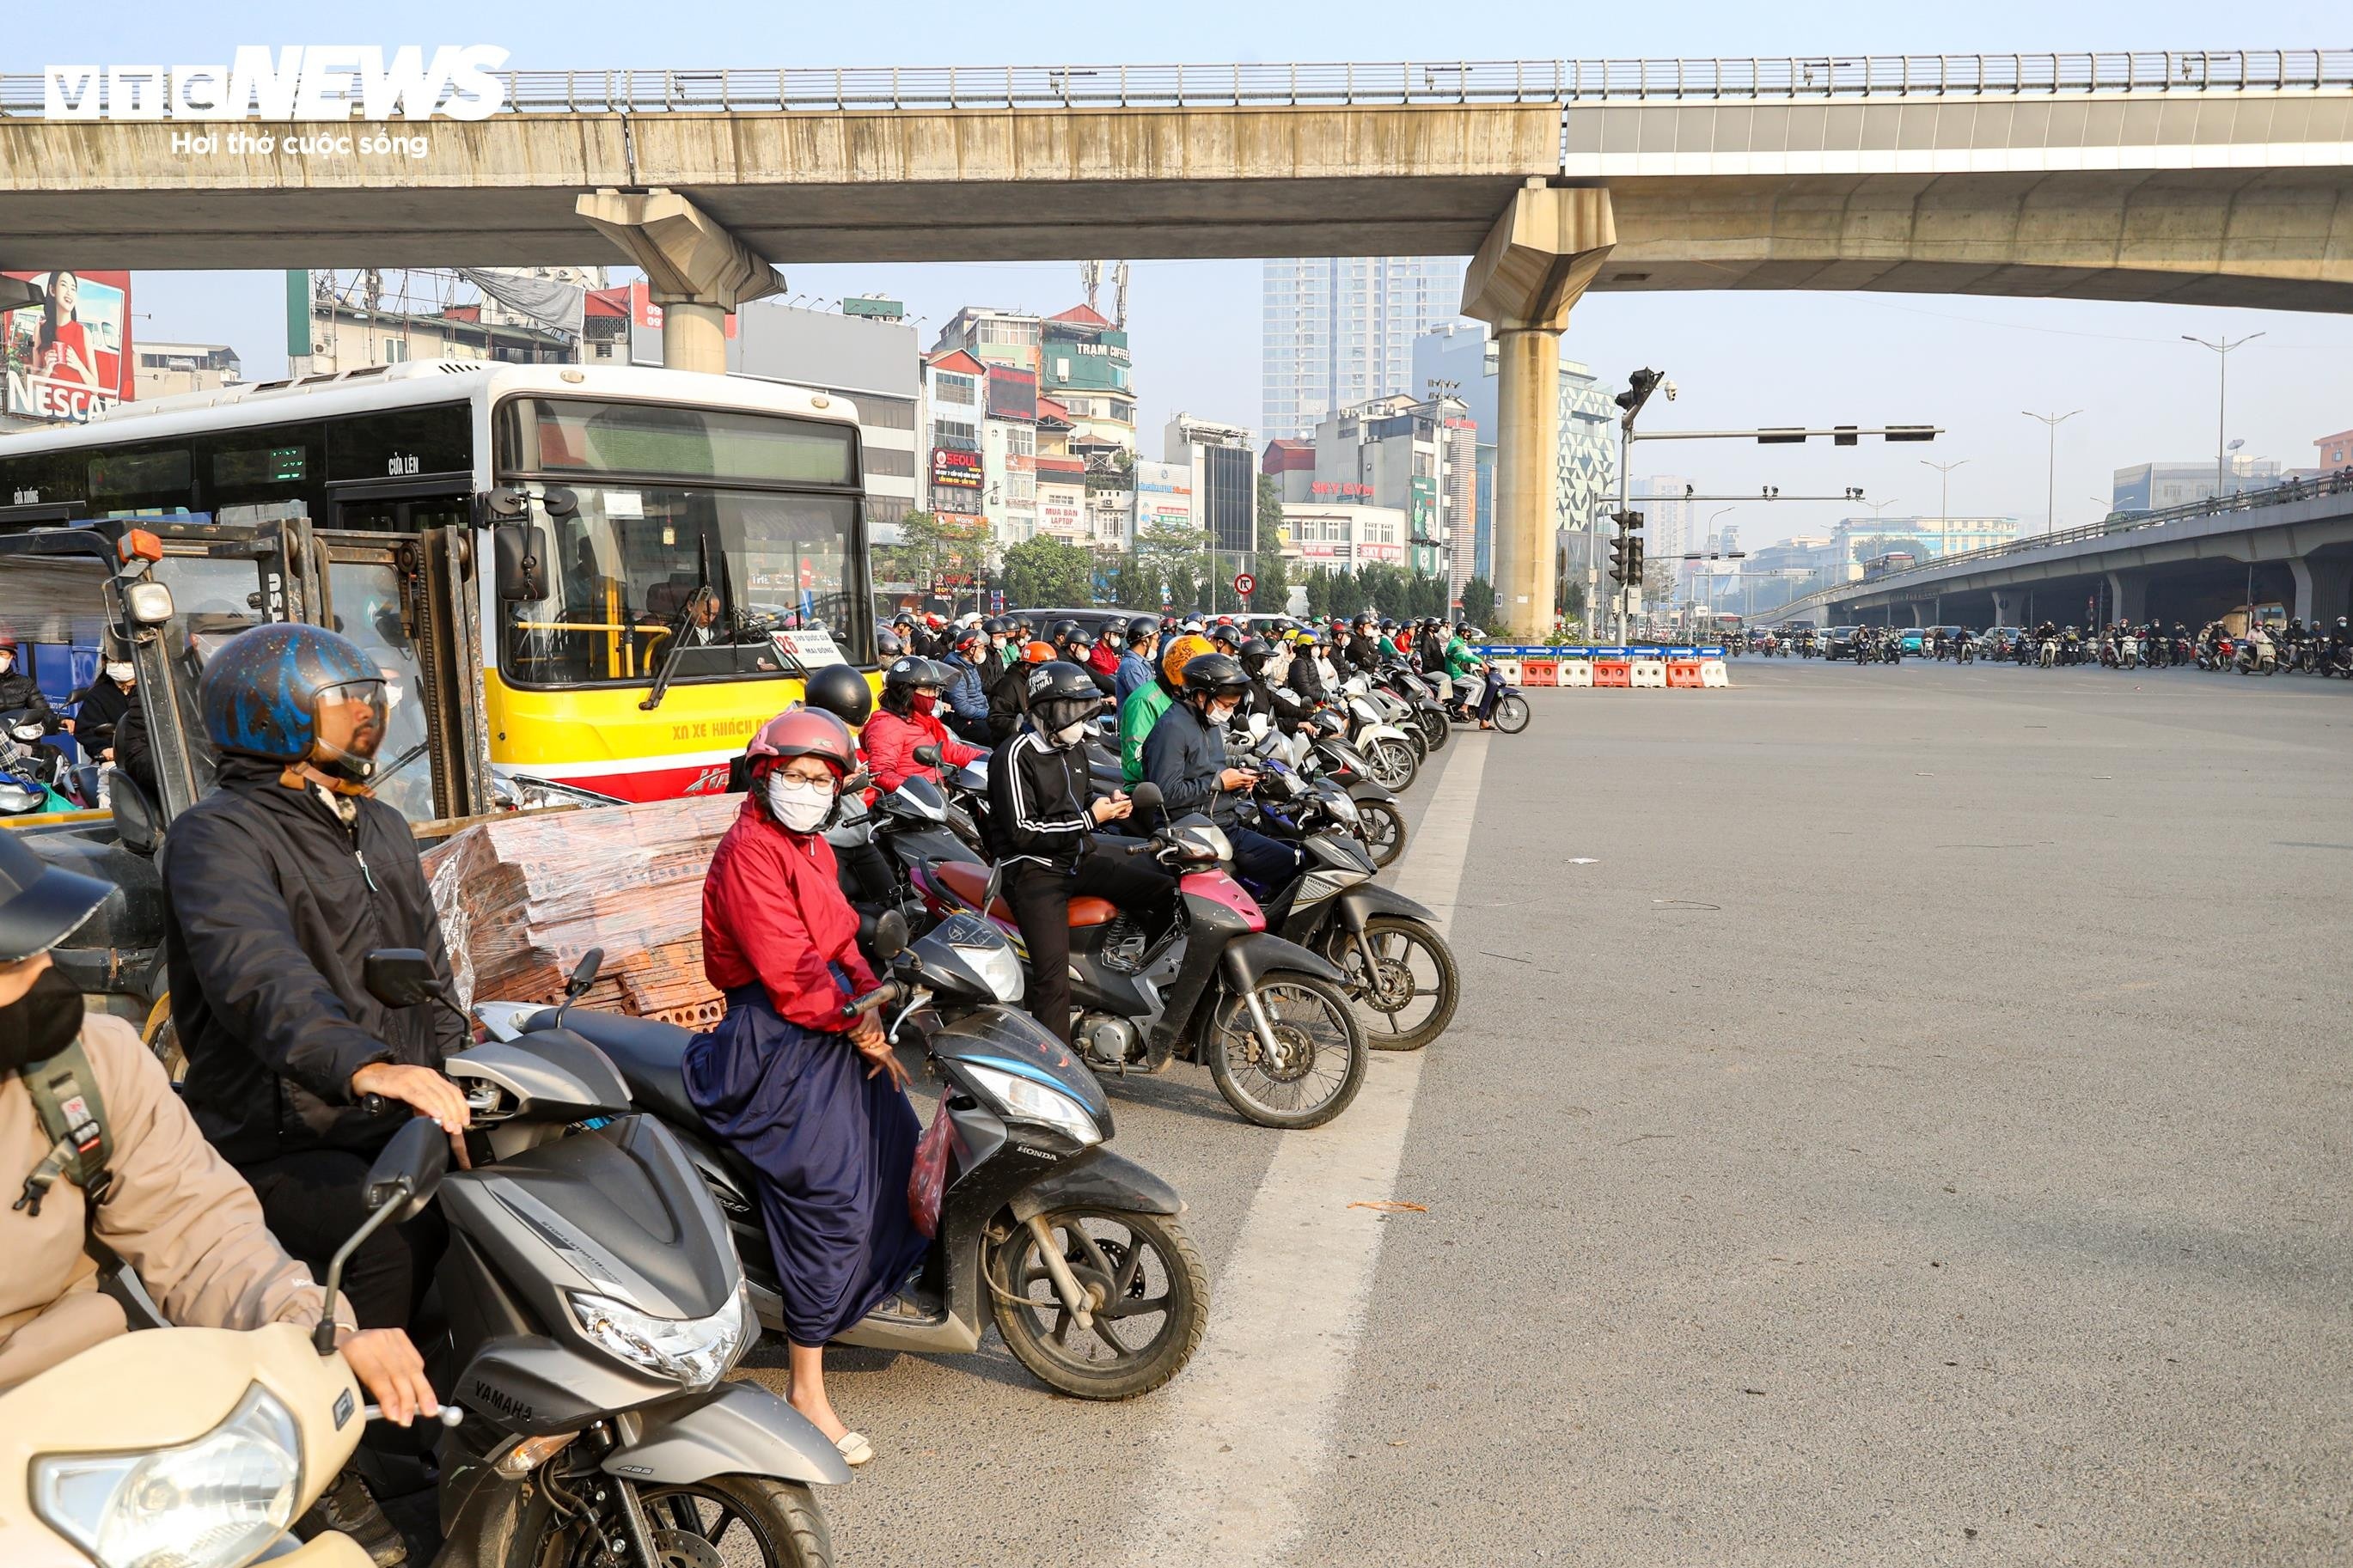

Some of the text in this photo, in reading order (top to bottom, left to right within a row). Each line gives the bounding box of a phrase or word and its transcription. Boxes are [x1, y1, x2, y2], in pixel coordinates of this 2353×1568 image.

[647, 305, 663, 315] 09
[647, 317, 663, 326] 09
[1077, 344, 1130, 361] TRẠM COFFEE
[388, 451, 404, 475] CỬA
[946, 454, 976, 467] SEOUL
[1312, 481, 1375, 496] SKY GYM
[955, 516, 974, 526] Wang
[1361, 546, 1379, 556] SKY
[1382, 547, 1401, 558] GYM
[777, 636, 799, 654] 26
[673, 725, 689, 741] XN
[693, 723, 707, 738] XE
[712, 717, 753, 737] KHÁCH
[1307, 878, 1332, 891] HONDA
[1017, 1145, 1058, 1162] HONDA
[475, 1380, 534, 1422] YAMAHA
